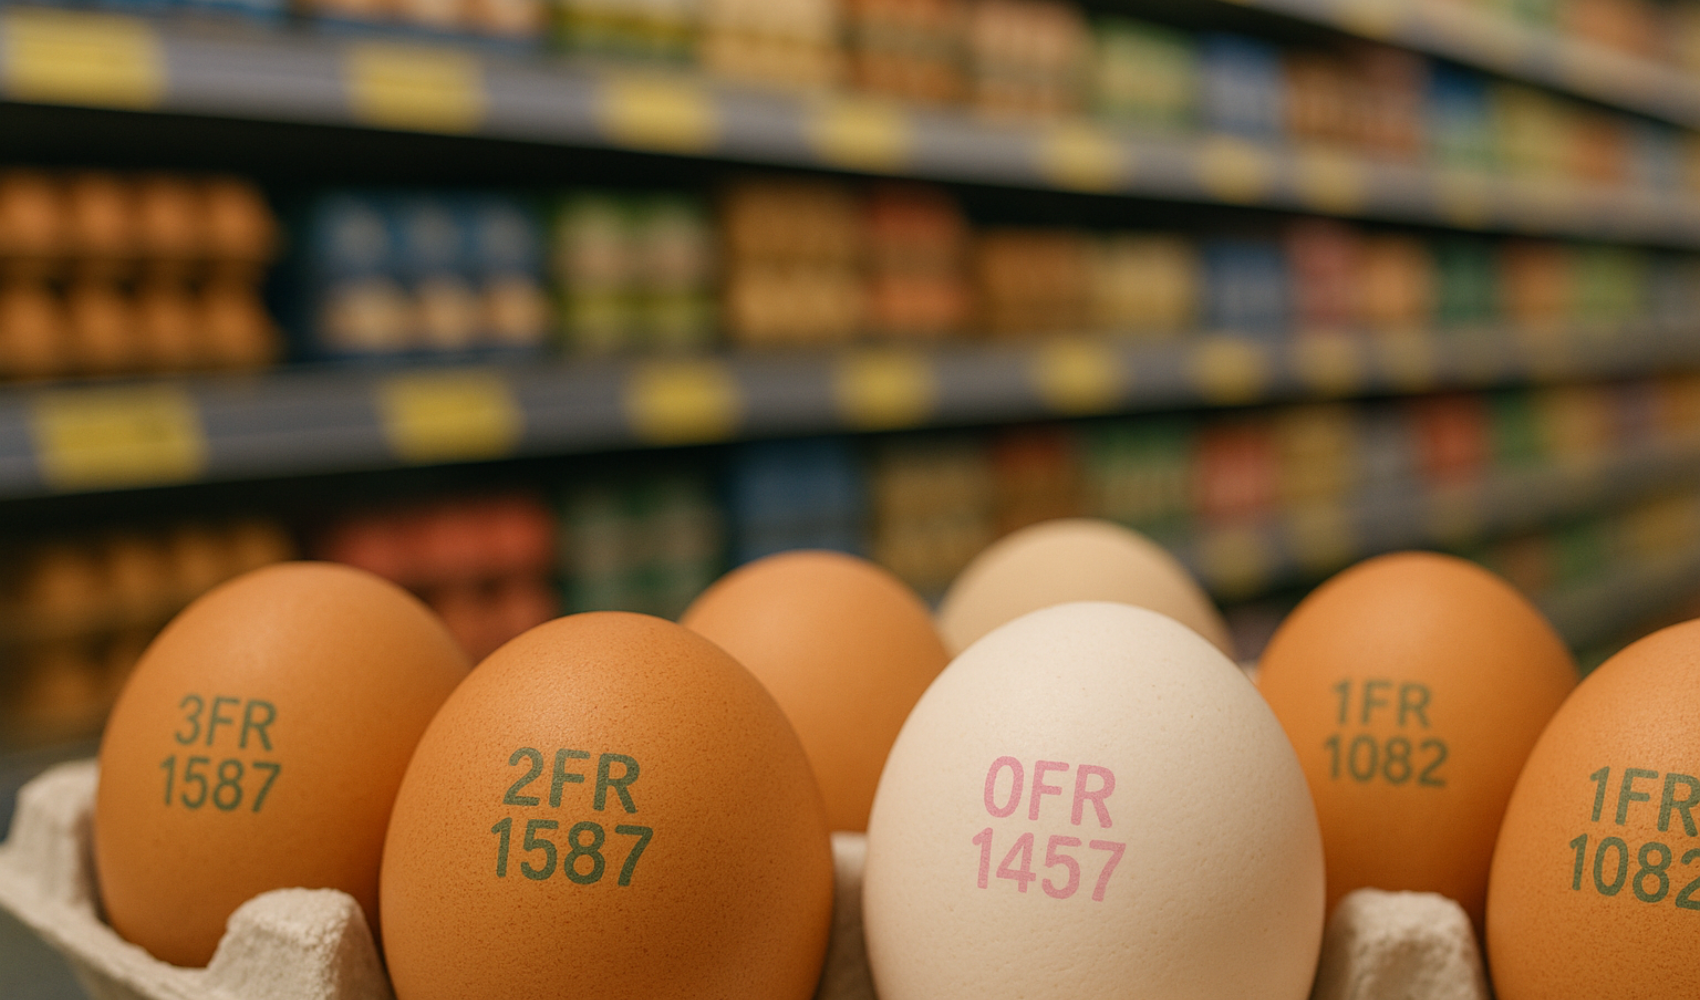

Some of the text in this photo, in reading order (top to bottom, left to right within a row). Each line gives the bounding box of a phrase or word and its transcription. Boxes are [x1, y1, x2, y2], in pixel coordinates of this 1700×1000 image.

[174, 693, 279, 751] 3FR
[1331, 678, 1433, 730] 1FR
[159, 755, 282, 812] 1587
[502, 746, 641, 814] 2FR
[983, 755, 1118, 829] 0FR
[1323, 734, 1450, 788] 1082
[1589, 766, 1700, 837] 1FR
[490, 817, 654, 887] 1587
[972, 827, 1127, 903] 1457
[1568, 833, 1700, 912] 1082
